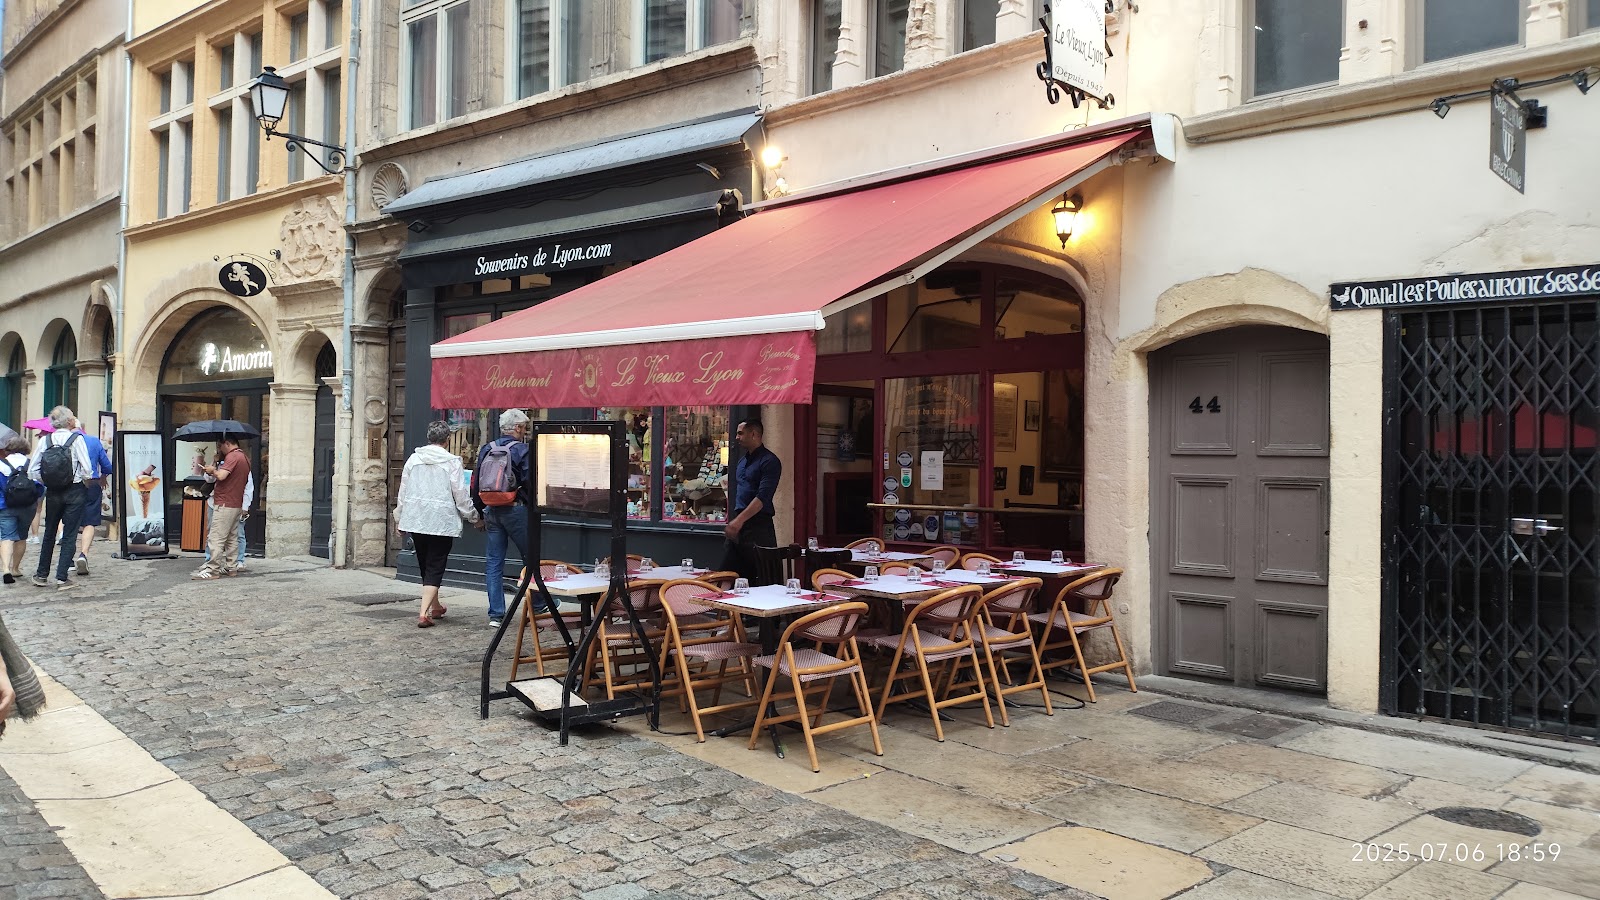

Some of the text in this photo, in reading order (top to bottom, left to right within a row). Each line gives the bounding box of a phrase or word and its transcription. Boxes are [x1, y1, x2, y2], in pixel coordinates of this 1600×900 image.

[1054, 23, 1104, 67] Le Vieux Lyon
[1054, 65, 1104, 93] Depuis 1947
[474, 243, 612, 276] Souvenirs de Lyon.com
[757, 343, 801, 366] Bouchon
[481, 364, 553, 391] Restaurant
[610, 356, 638, 387] Le
[643, 354, 685, 386] Vieux
[692, 351, 744, 396] Lyon
[1188, 395, 1221, 414] 44
[560, 425, 582, 434] MENU
